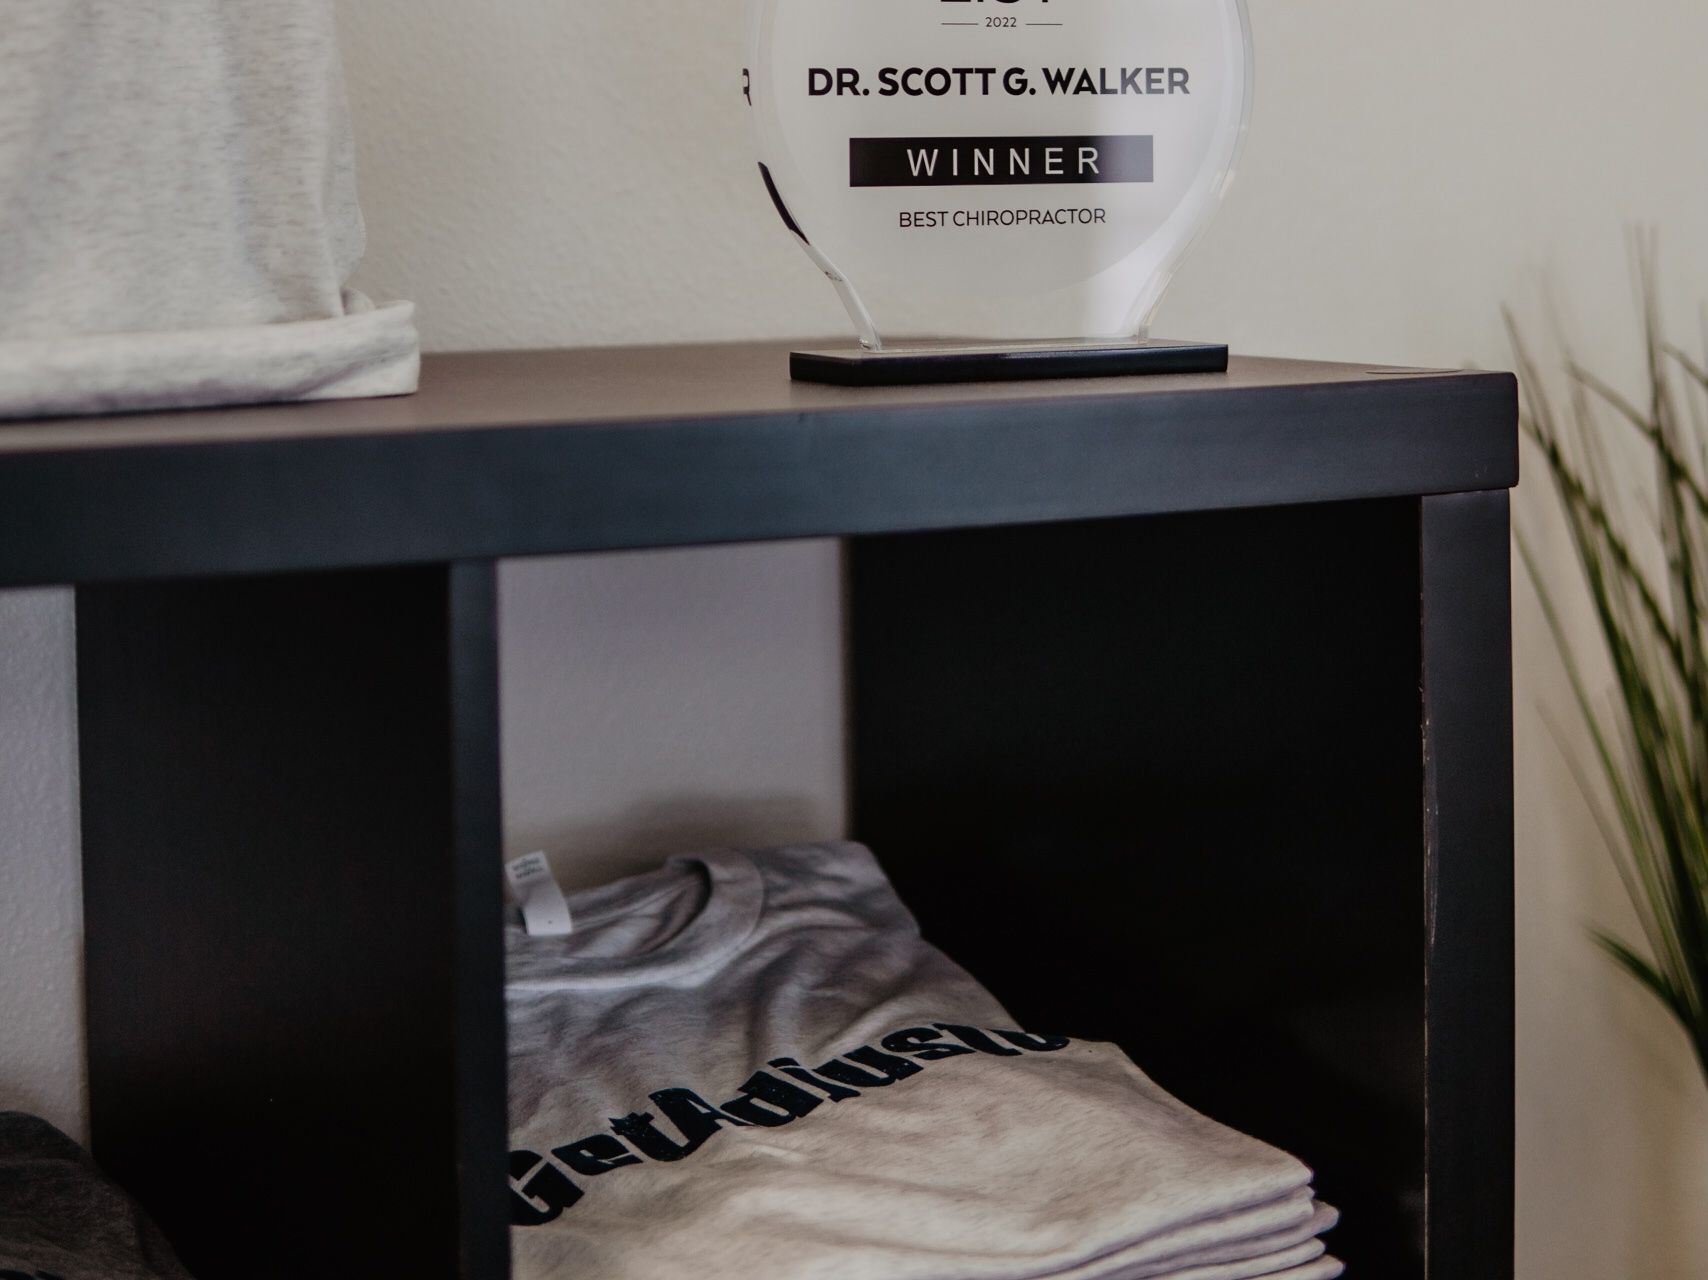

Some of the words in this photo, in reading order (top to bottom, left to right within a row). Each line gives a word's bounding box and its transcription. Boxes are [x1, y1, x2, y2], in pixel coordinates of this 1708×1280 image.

[984, 16, 1018, 28] 2022
[808, 67, 870, 97] DR.
[877, 67, 997, 97] SCOTT
[1002, 67, 1037, 97] G.
[1042, 67, 1191, 97] WALKER
[907, 147, 1101, 177] WINNER
[899, 210, 950, 228] BEST
[952, 208, 1107, 227] CHIROPRACTOR
